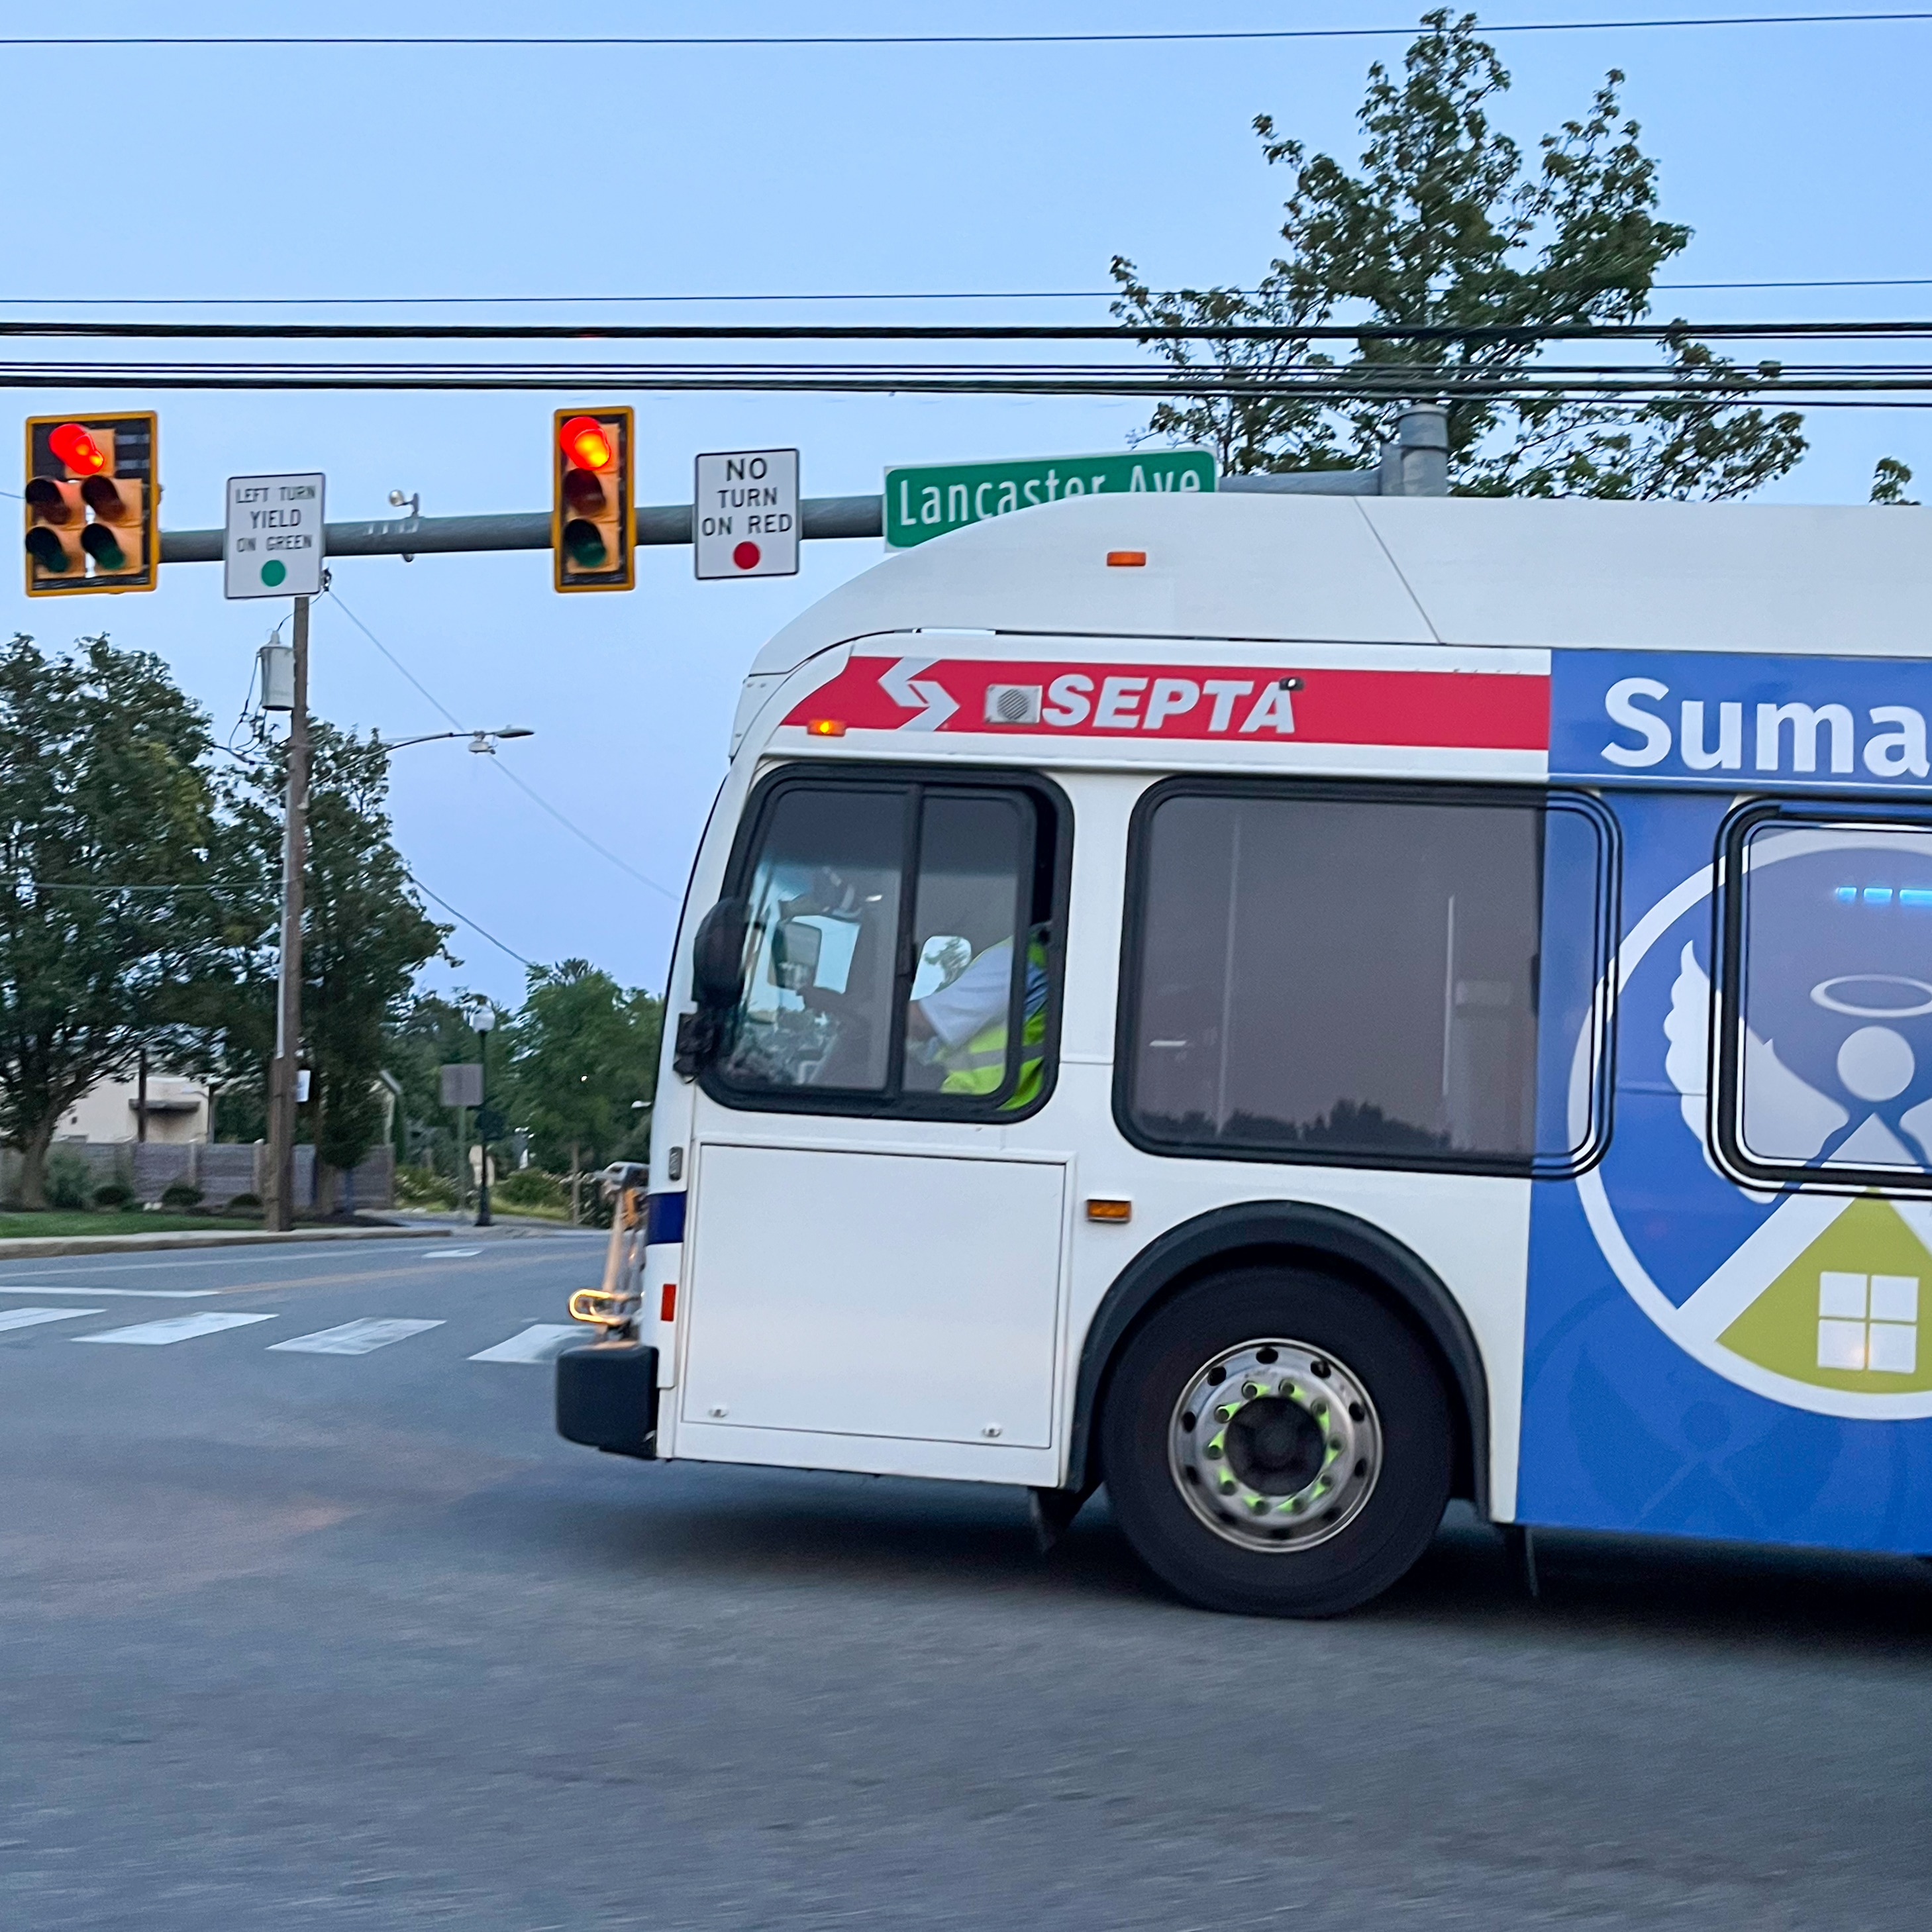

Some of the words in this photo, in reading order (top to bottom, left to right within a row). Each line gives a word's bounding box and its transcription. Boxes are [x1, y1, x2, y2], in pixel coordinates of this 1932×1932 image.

[727, 458, 768, 482] NO
[235, 487, 269, 503] LEFT
[279, 485, 315, 501] TURN
[716, 487, 778, 508] TURN
[901, 469, 1106, 525] Lancaster
[1130, 465, 1201, 493] Ave
[250, 509, 301, 529] YIELD
[701, 516, 733, 536] ON
[748, 513, 793, 534] RED
[236, 537, 256, 552] ON
[266, 534, 312, 551] GREEN
[1042, 674, 1296, 733] SEPTA
[1601, 677, 1931, 778] Suma
